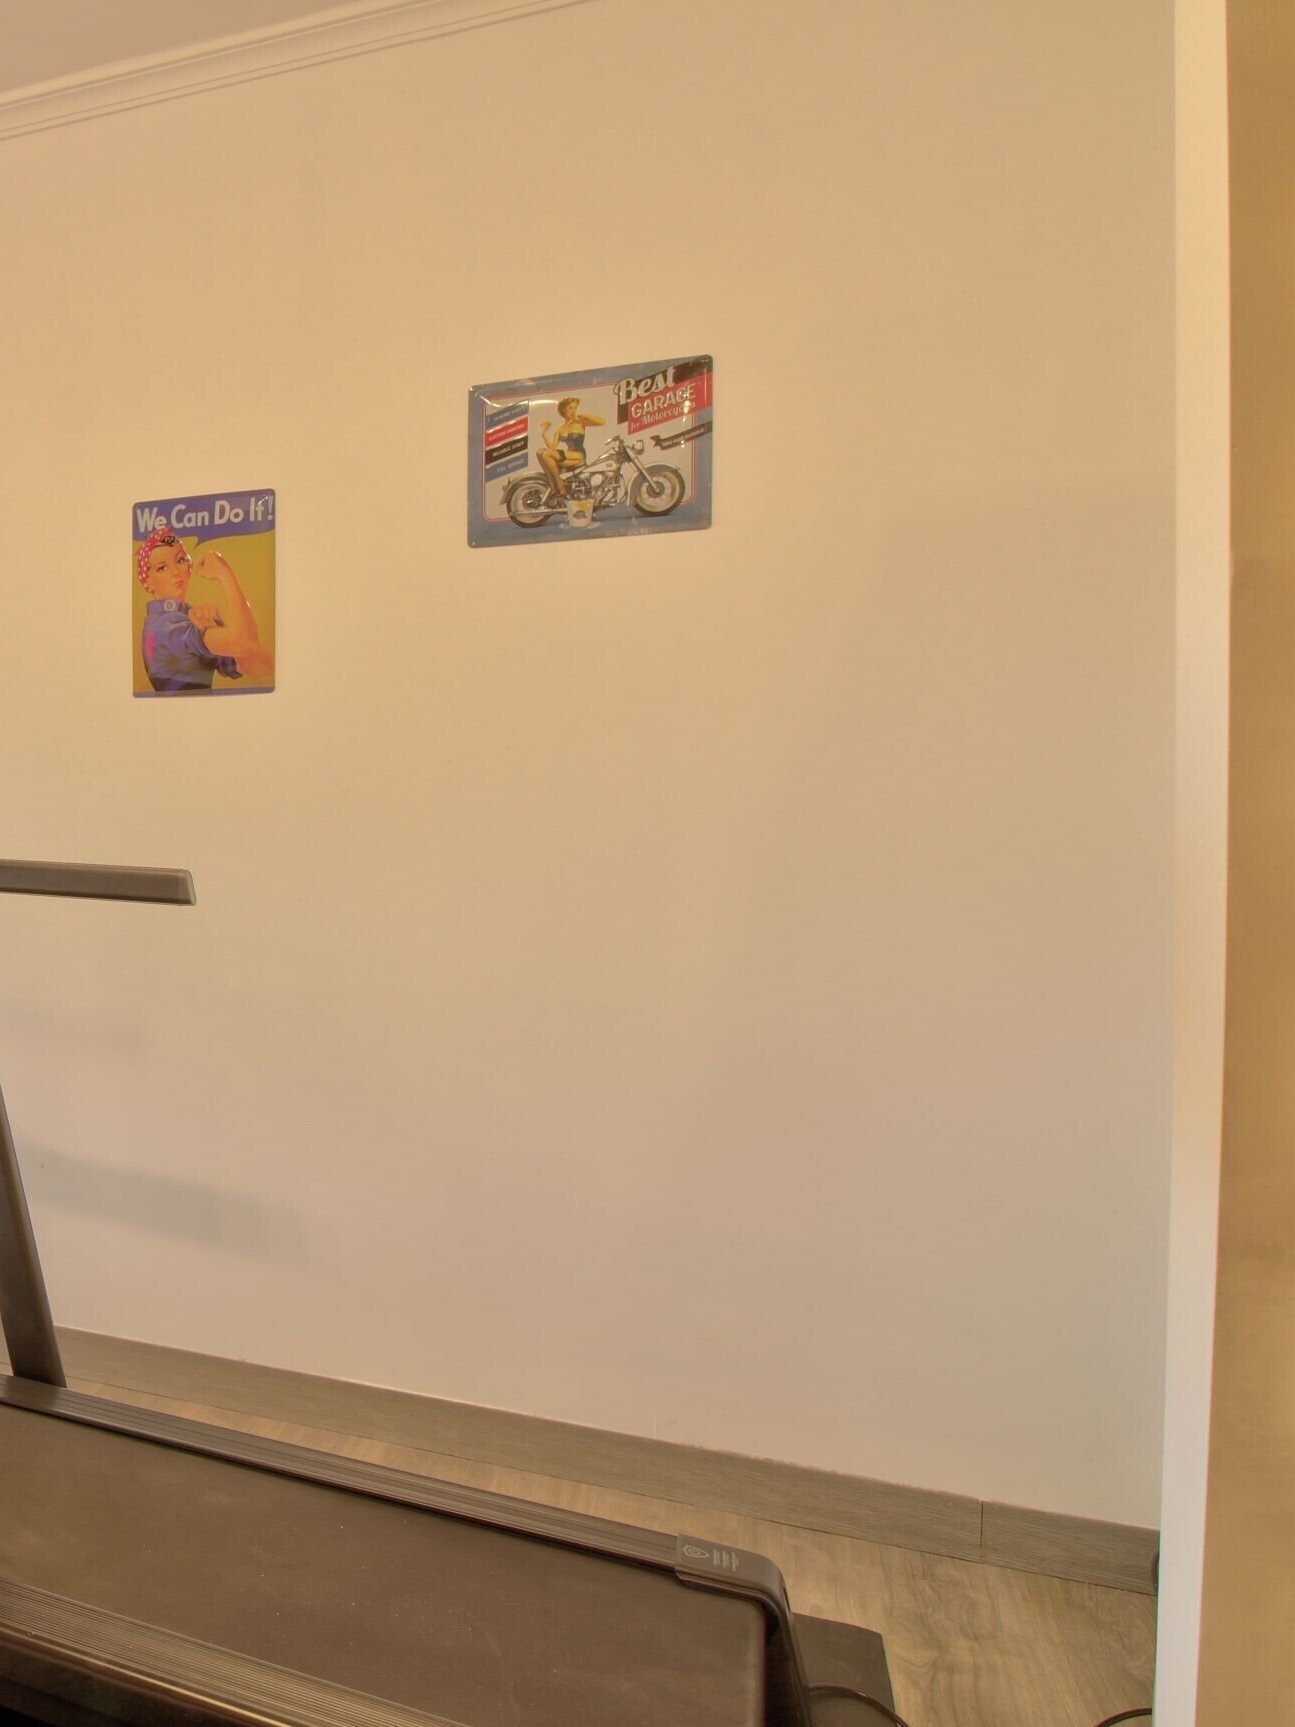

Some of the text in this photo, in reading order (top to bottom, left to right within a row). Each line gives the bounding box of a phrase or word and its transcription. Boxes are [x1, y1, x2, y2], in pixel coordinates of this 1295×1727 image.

[613, 366, 675, 405] Best
[631, 382, 696, 419] GARAGE
[136, 495, 274, 533] We Can Do It!
